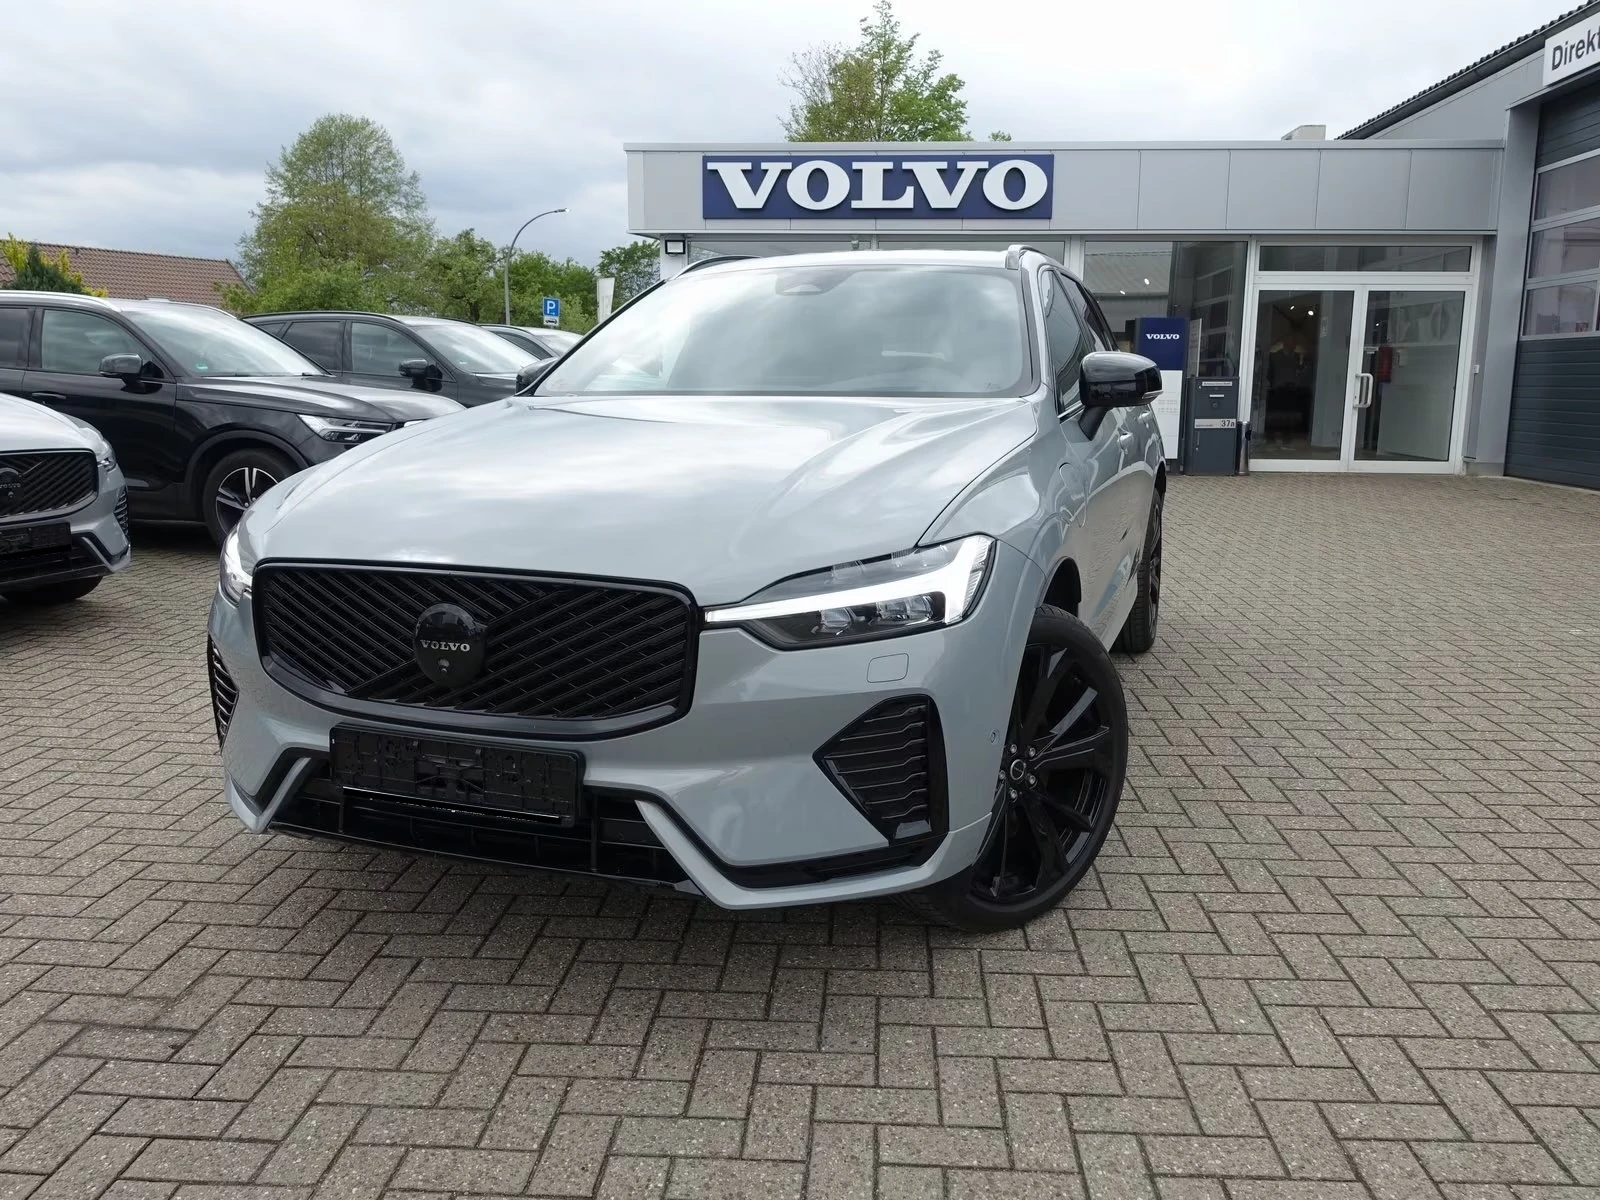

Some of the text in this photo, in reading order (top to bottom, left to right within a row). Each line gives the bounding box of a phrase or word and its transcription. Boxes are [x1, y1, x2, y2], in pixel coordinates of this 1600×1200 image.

[707, 159, 1048, 211] VOLVO
[546, 300, 556, 314] P
[420, 639, 471, 652] VOLVO
